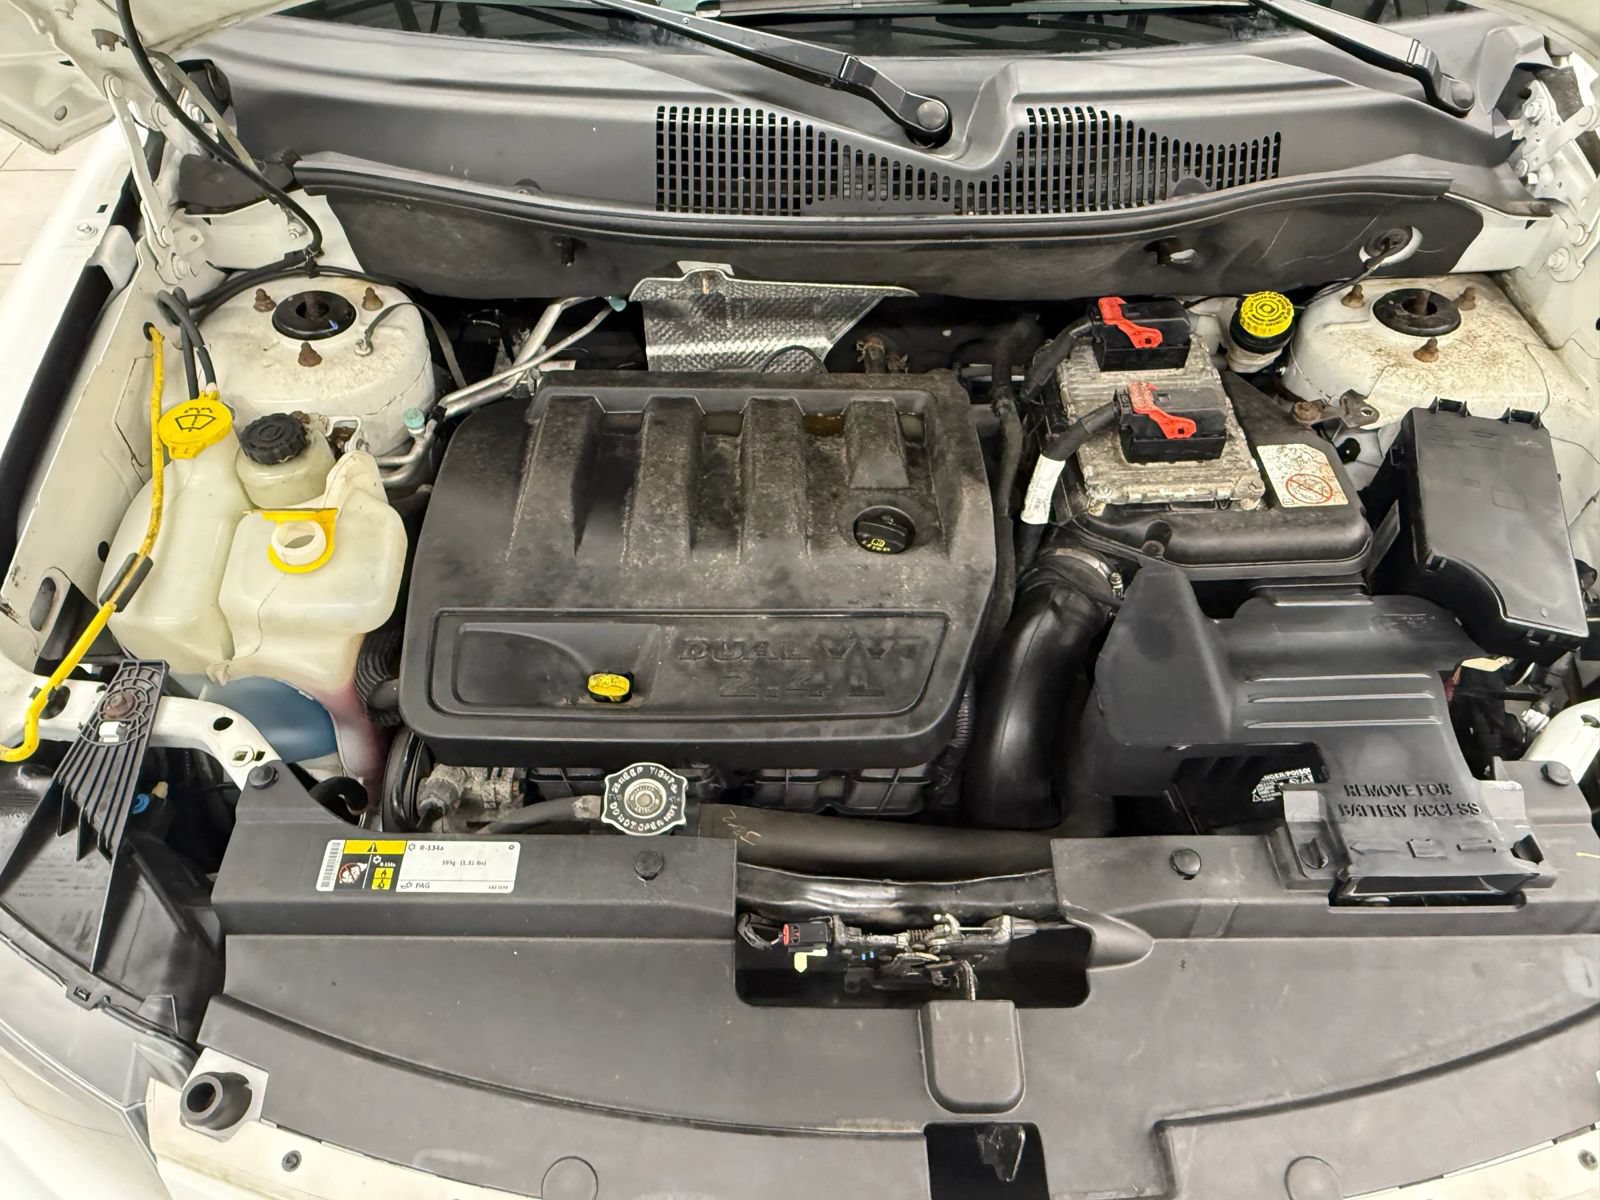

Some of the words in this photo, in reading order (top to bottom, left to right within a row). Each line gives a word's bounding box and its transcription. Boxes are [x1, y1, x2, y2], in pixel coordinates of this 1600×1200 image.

[679, 638, 811, 661] DUAL
[1343, 783, 1416, 798] REMOVE
[1415, 782, 1453, 797] FOR
[609, 801, 620, 816] DO
[617, 814, 638, 829] NOT
[637, 818, 665, 832] OPEN
[1337, 803, 1407, 818] BATTERY
[1412, 802, 1482, 818] ACCESS
